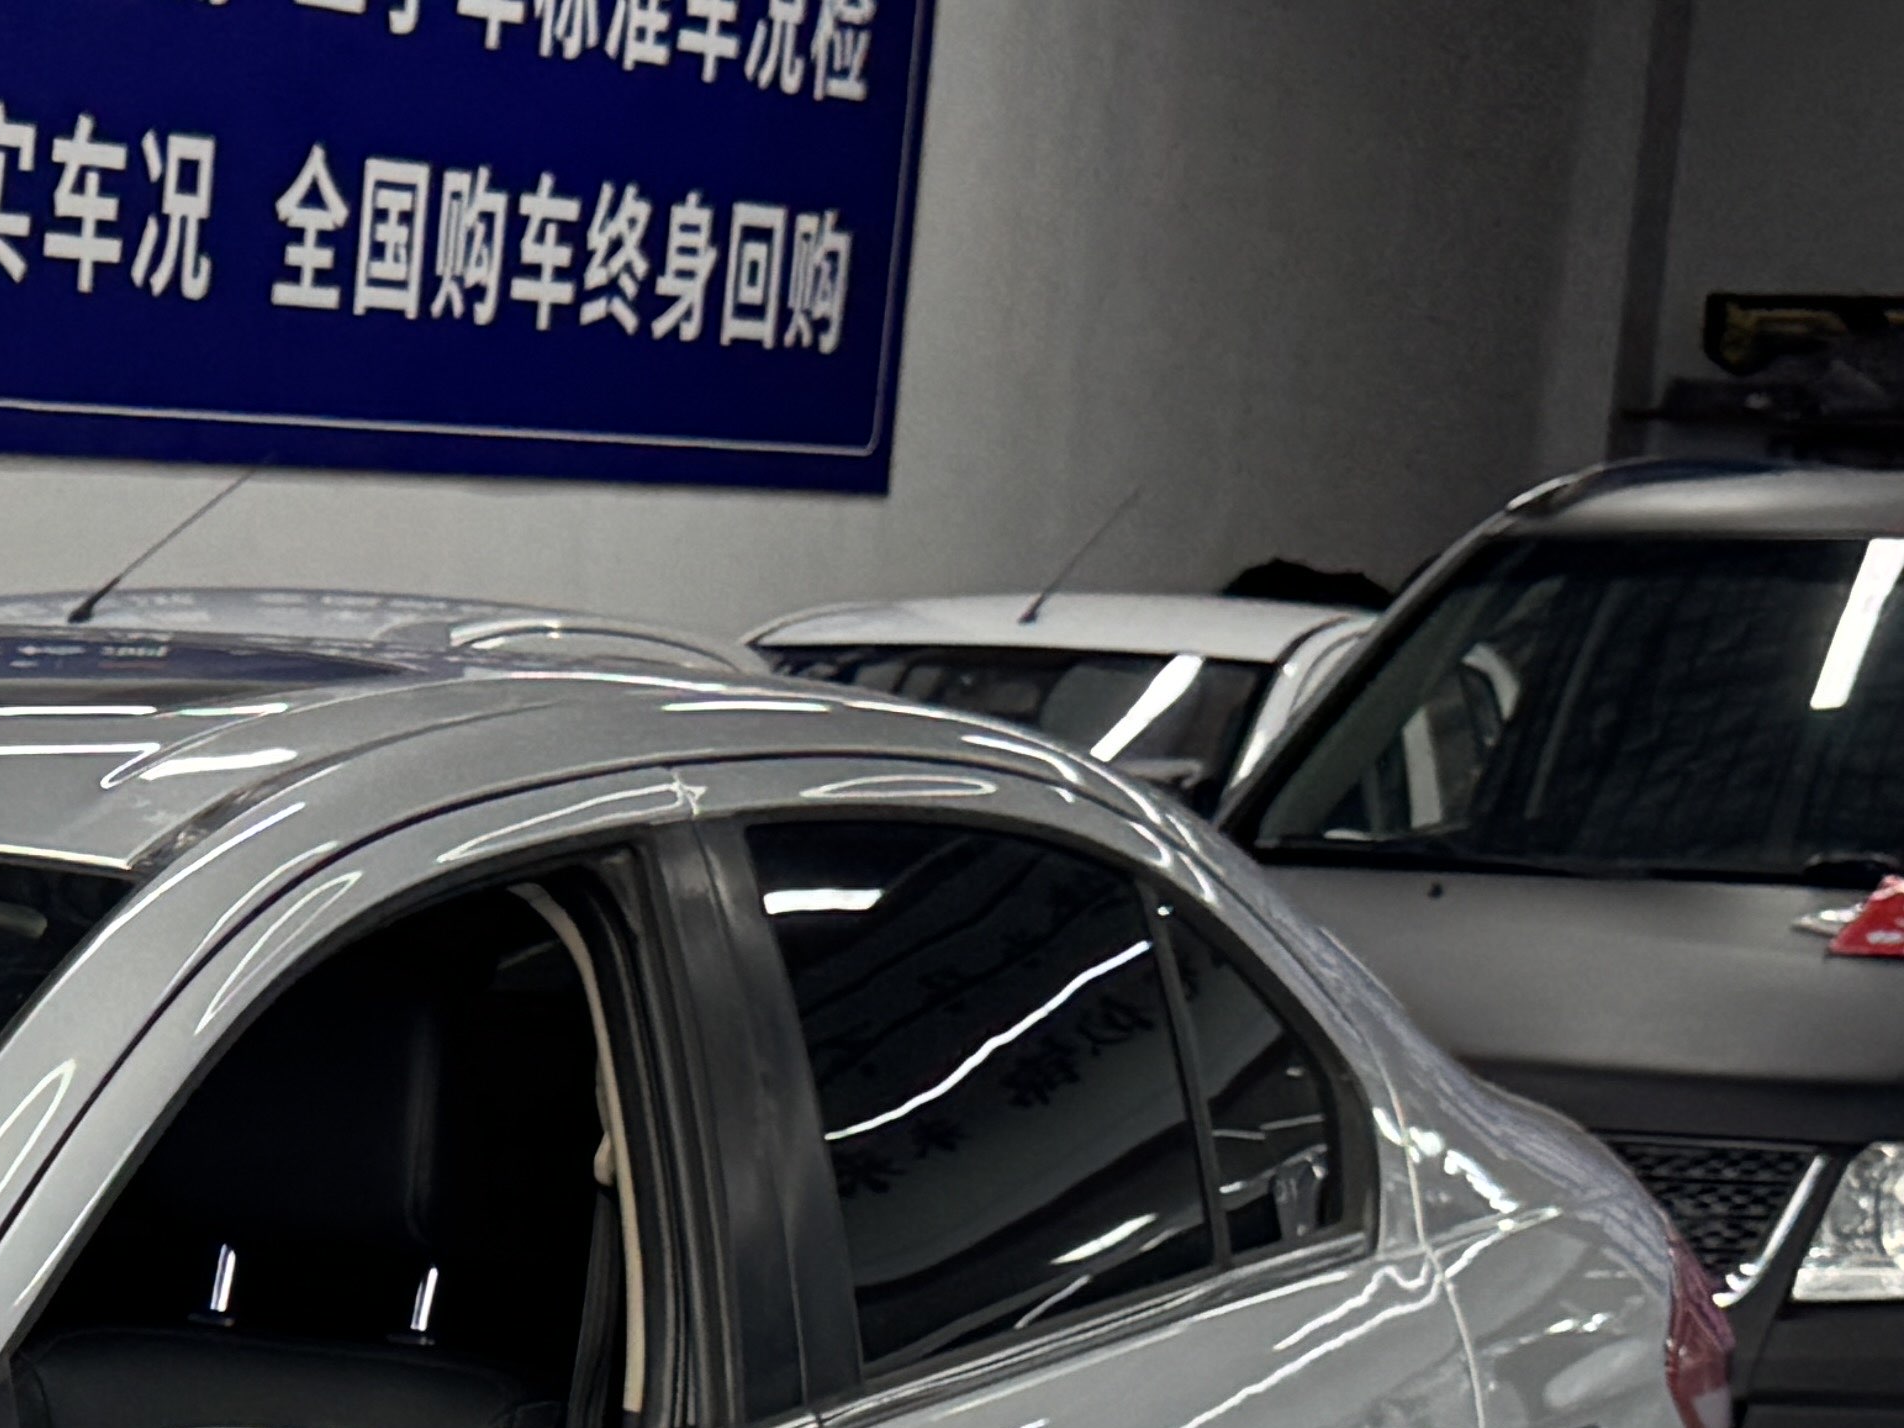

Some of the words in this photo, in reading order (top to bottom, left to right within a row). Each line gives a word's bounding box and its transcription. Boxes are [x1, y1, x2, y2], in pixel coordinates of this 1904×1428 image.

[272, 143, 854, 356] 全国购车终身回购
